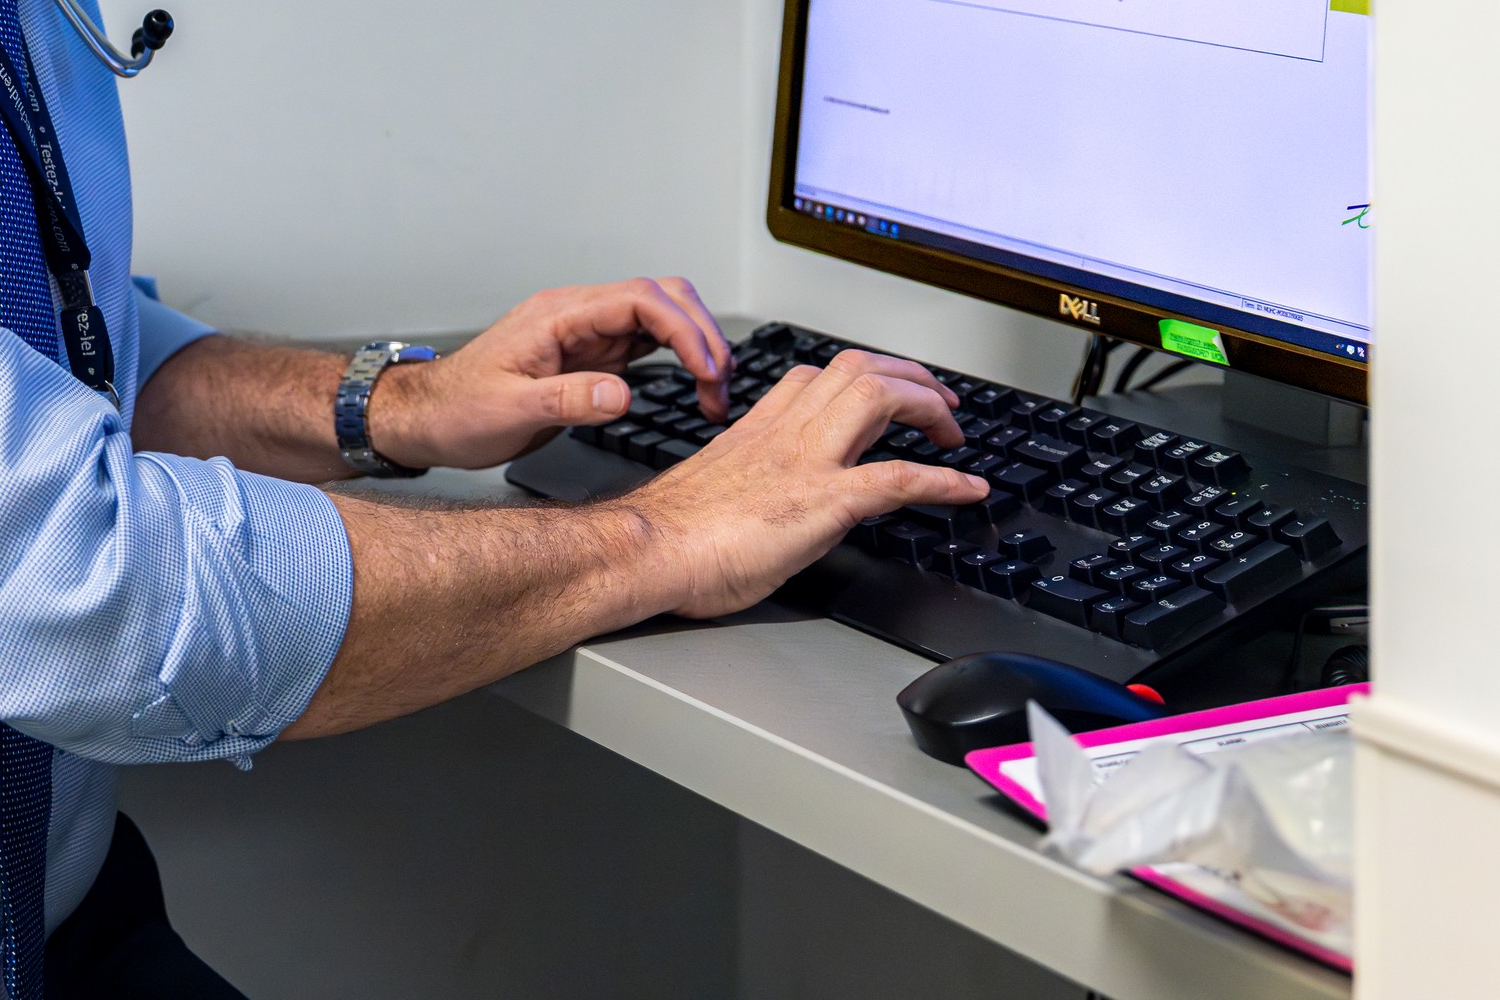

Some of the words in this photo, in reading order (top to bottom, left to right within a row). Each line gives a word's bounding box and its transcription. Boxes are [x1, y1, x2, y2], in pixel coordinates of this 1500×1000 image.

[1059, 293, 1101, 325] DELL
[1166, 511, 1180, 519] 7
[1152, 519, 1171, 528] Home
[1198, 521, 1211, 529] 8
[1230, 531, 1244, 539] 9
[1158, 599, 1179, 609] Enter
